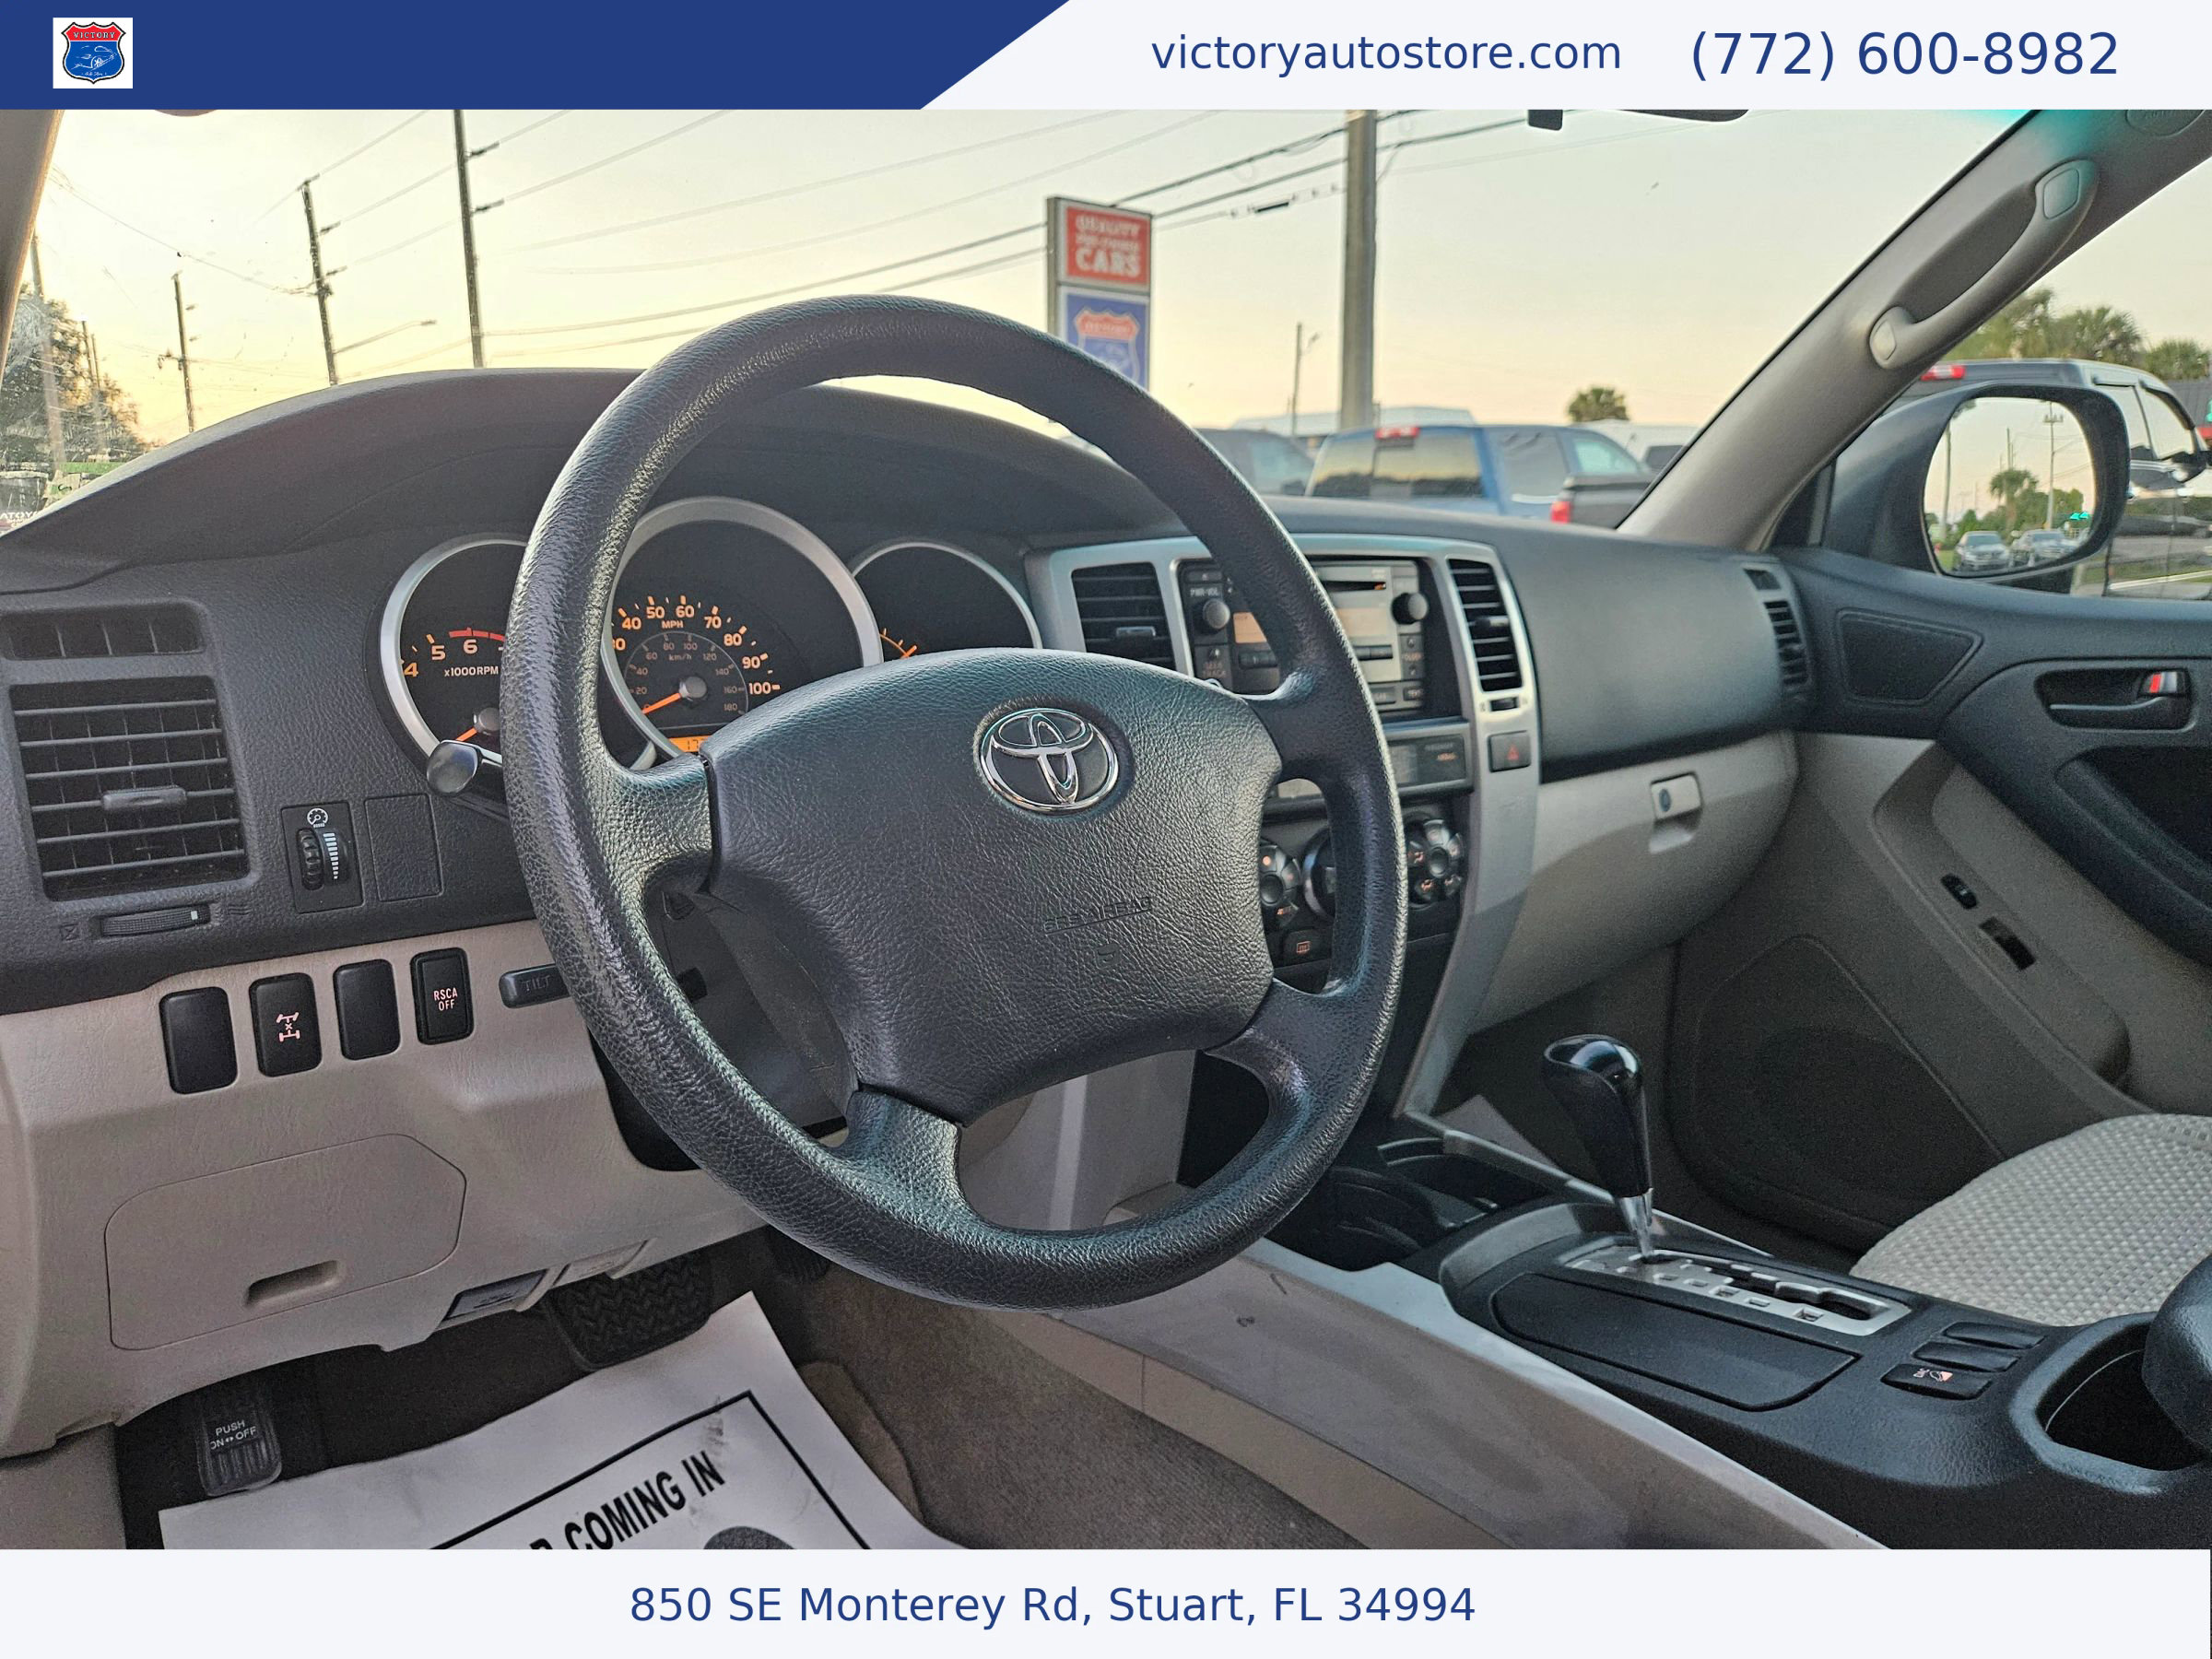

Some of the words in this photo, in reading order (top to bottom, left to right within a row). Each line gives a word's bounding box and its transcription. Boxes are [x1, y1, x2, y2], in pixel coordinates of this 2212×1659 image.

[1076, 247, 1139, 277] CARS
[646, 606, 665, 619] 50
[676, 605, 695, 618] 60
[621, 617, 641, 630] 40
[661, 619, 684, 629] MPH
[703, 616, 722, 629] 70
[663, 641, 675, 651] 80
[683, 641, 698, 651] 100
[724, 633, 743, 646] 80
[431, 645, 446, 661] 5
[463, 639, 478, 654] 6
[646, 652, 658, 660] 60
[668, 653, 692, 662] km/h
[702, 653, 717, 661] 120
[741, 656, 761, 669] 90
[404, 662, 419, 677] 4
[636, 667, 649, 676] 40
[715, 667, 730, 676] 140
[636, 687, 648, 695] 20
[724, 686, 737, 694] 160
[747, 682, 771, 695] 100
[724, 702, 737, 712] 180
[521, 975, 551, 992] TILT
[433, 987, 458, 1001] RSCA
[438, 999, 455, 1011] OFF
[215, 1419, 245, 1436] PUSH
[235, 1426, 256, 1440] OFF
[564, 1470, 686, 1549] COMING
[681, 1450, 726, 1497] IN
